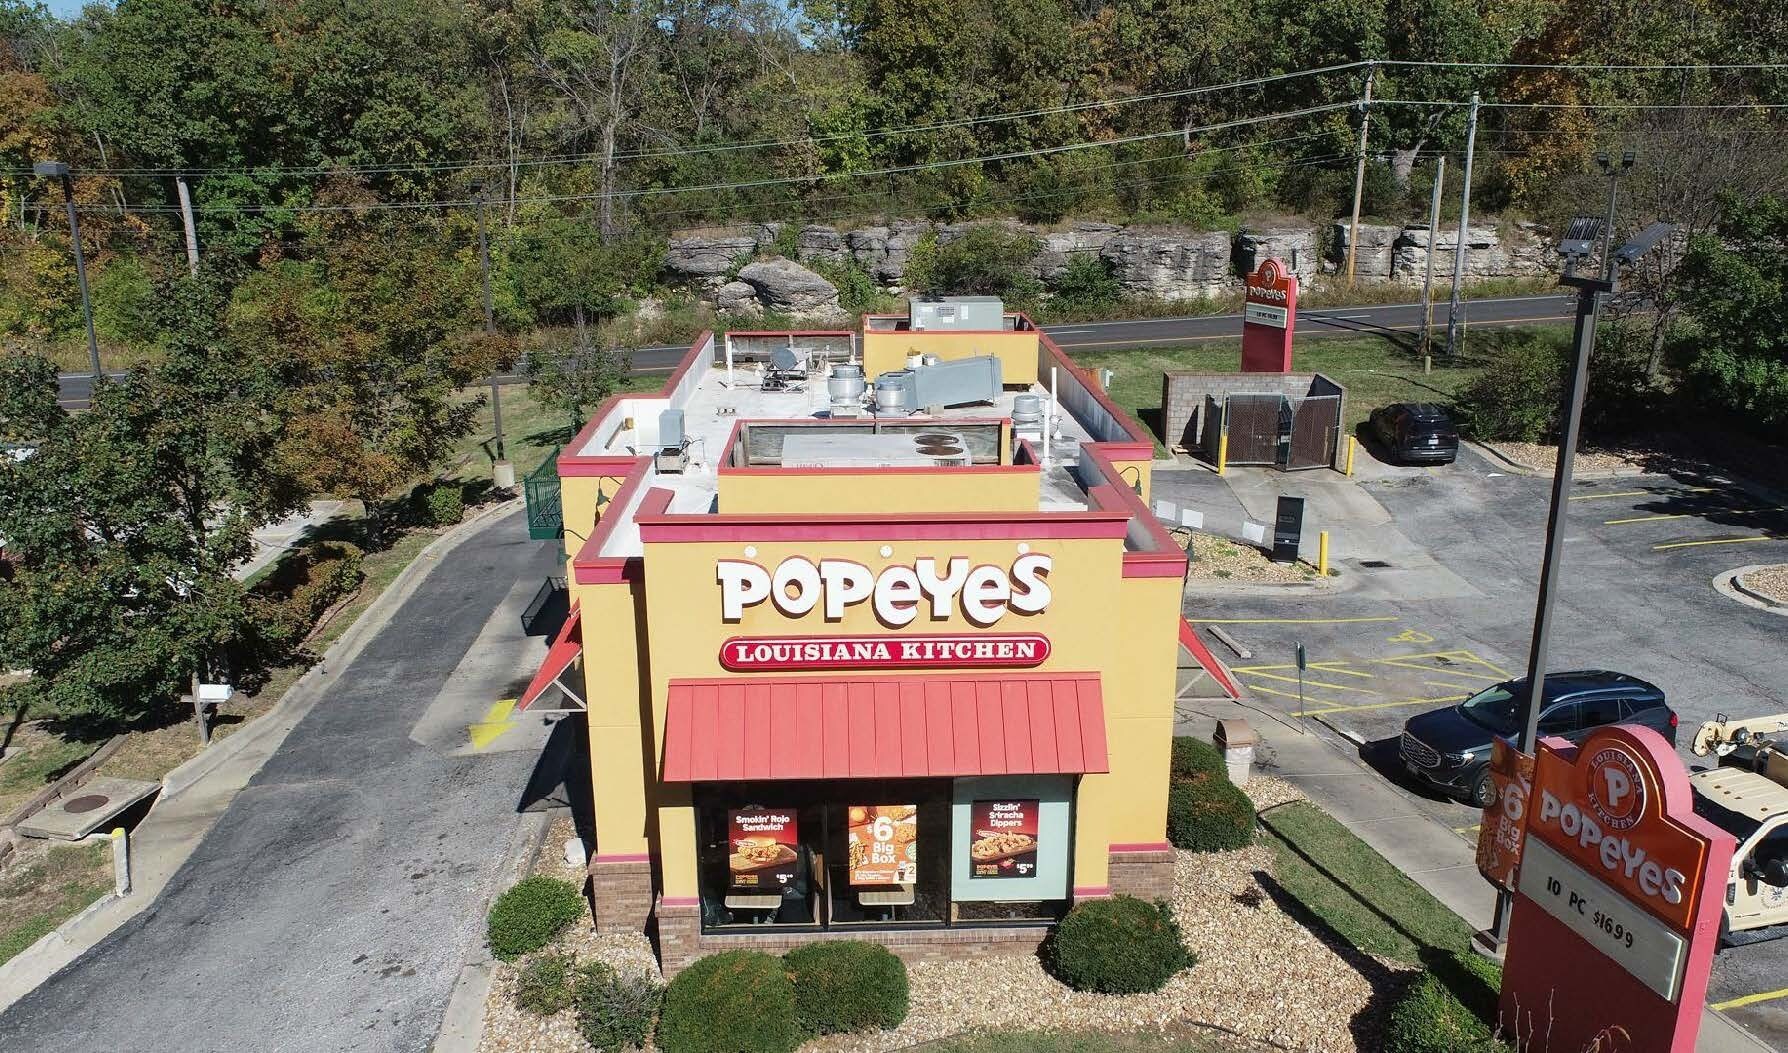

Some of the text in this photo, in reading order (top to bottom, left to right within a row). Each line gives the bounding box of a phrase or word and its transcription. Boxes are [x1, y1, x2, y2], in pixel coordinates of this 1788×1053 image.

[736, 641, 1036, 662] LOUISIANA KITCHEN
[1591, 751, 1643, 794] LOUISIANA
[1604, 767, 1630, 807] P
[735, 815, 790, 824] Smokin' Rojo
[742, 823, 783, 832] Sandwich
[990, 820, 1022, 828] Dippers
[1500, 816, 1521, 842] Big
[873, 842, 895, 854] Big
[872, 853, 896, 864] Box
[1546, 876, 1633, 948] 10 PC $1699
